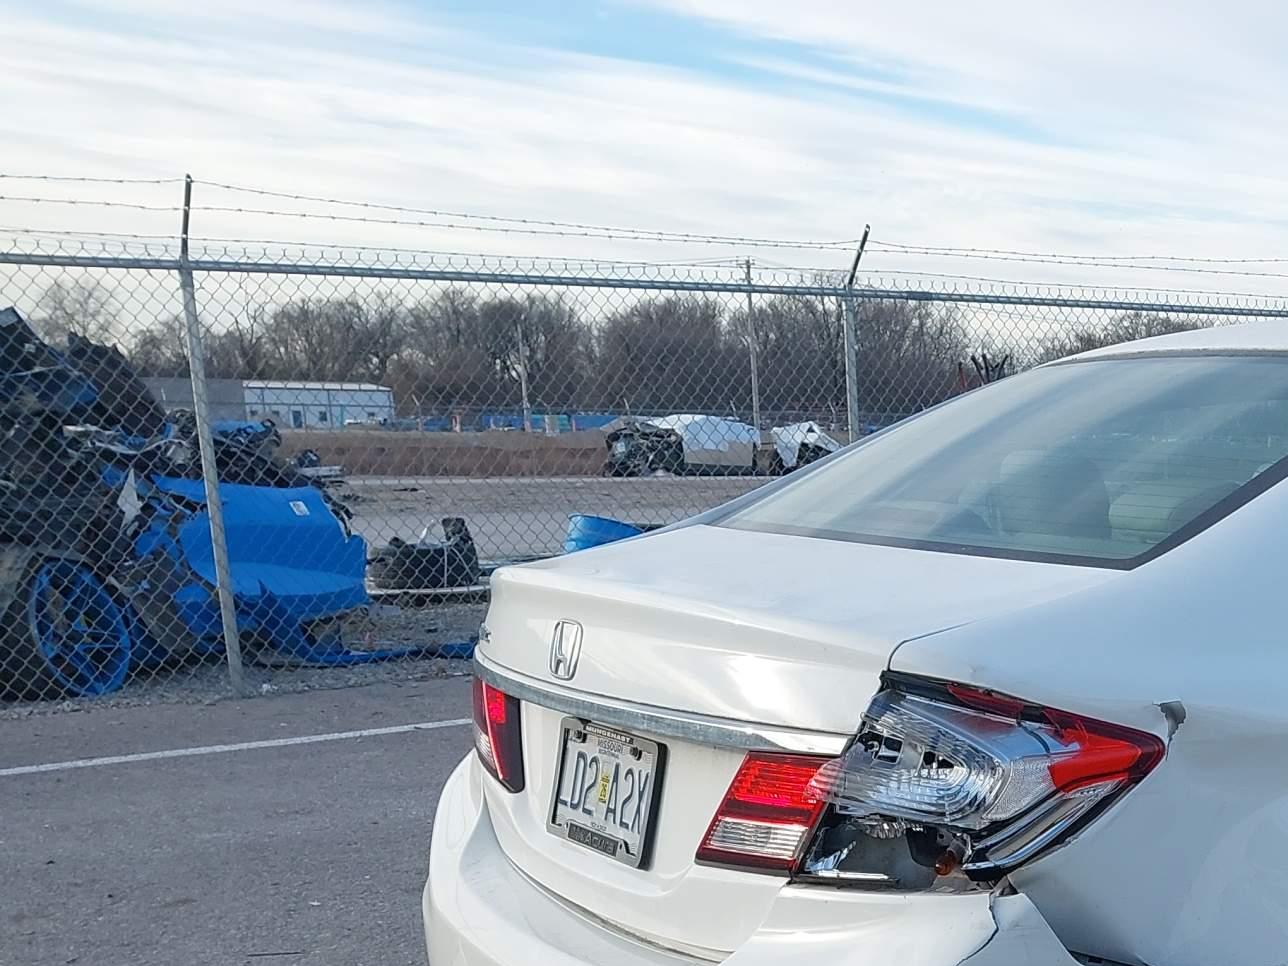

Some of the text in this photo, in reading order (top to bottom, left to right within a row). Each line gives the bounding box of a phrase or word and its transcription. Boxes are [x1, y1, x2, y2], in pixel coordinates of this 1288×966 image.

[585, 725, 631, 743] MUNGENAST
[597, 739, 624, 754] MISSOURI
[604, 762, 650, 835] A2X
